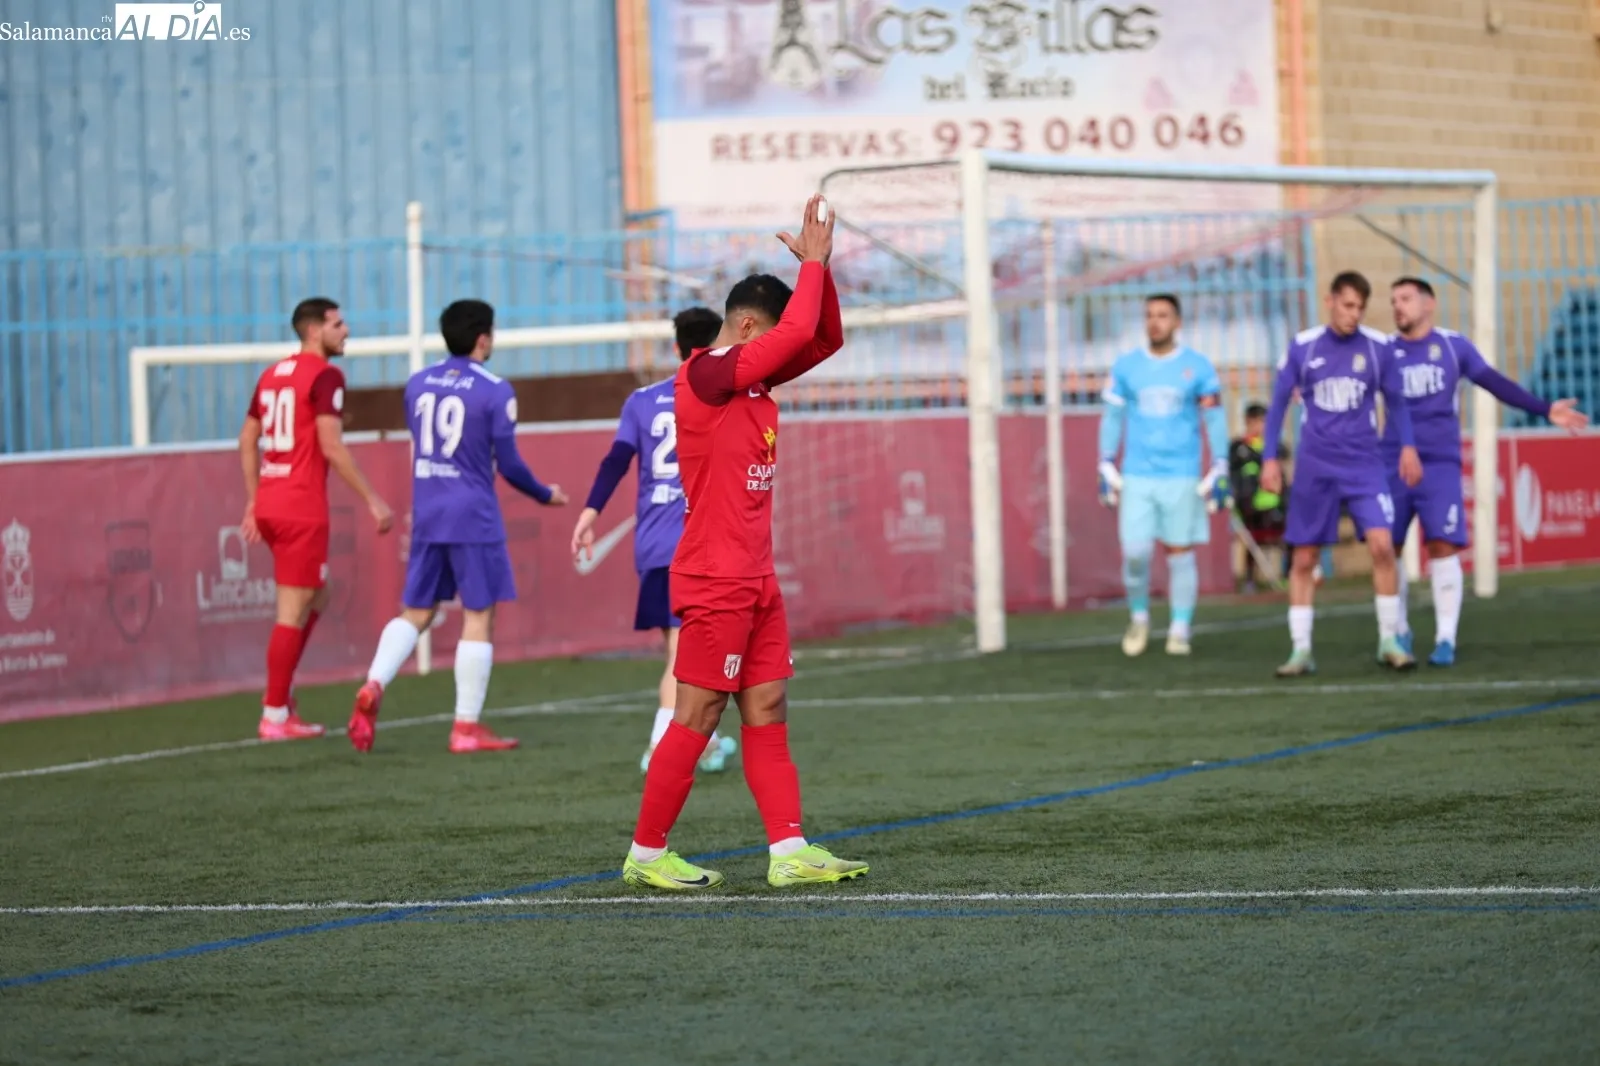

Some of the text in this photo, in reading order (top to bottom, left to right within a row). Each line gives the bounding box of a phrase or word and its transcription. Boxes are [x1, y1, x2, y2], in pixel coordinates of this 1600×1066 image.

[711, 113, 1246, 162] RESERVAS: 923 040 046
[258, 387, 296, 452] 20
[415, 392, 465, 459] 19
